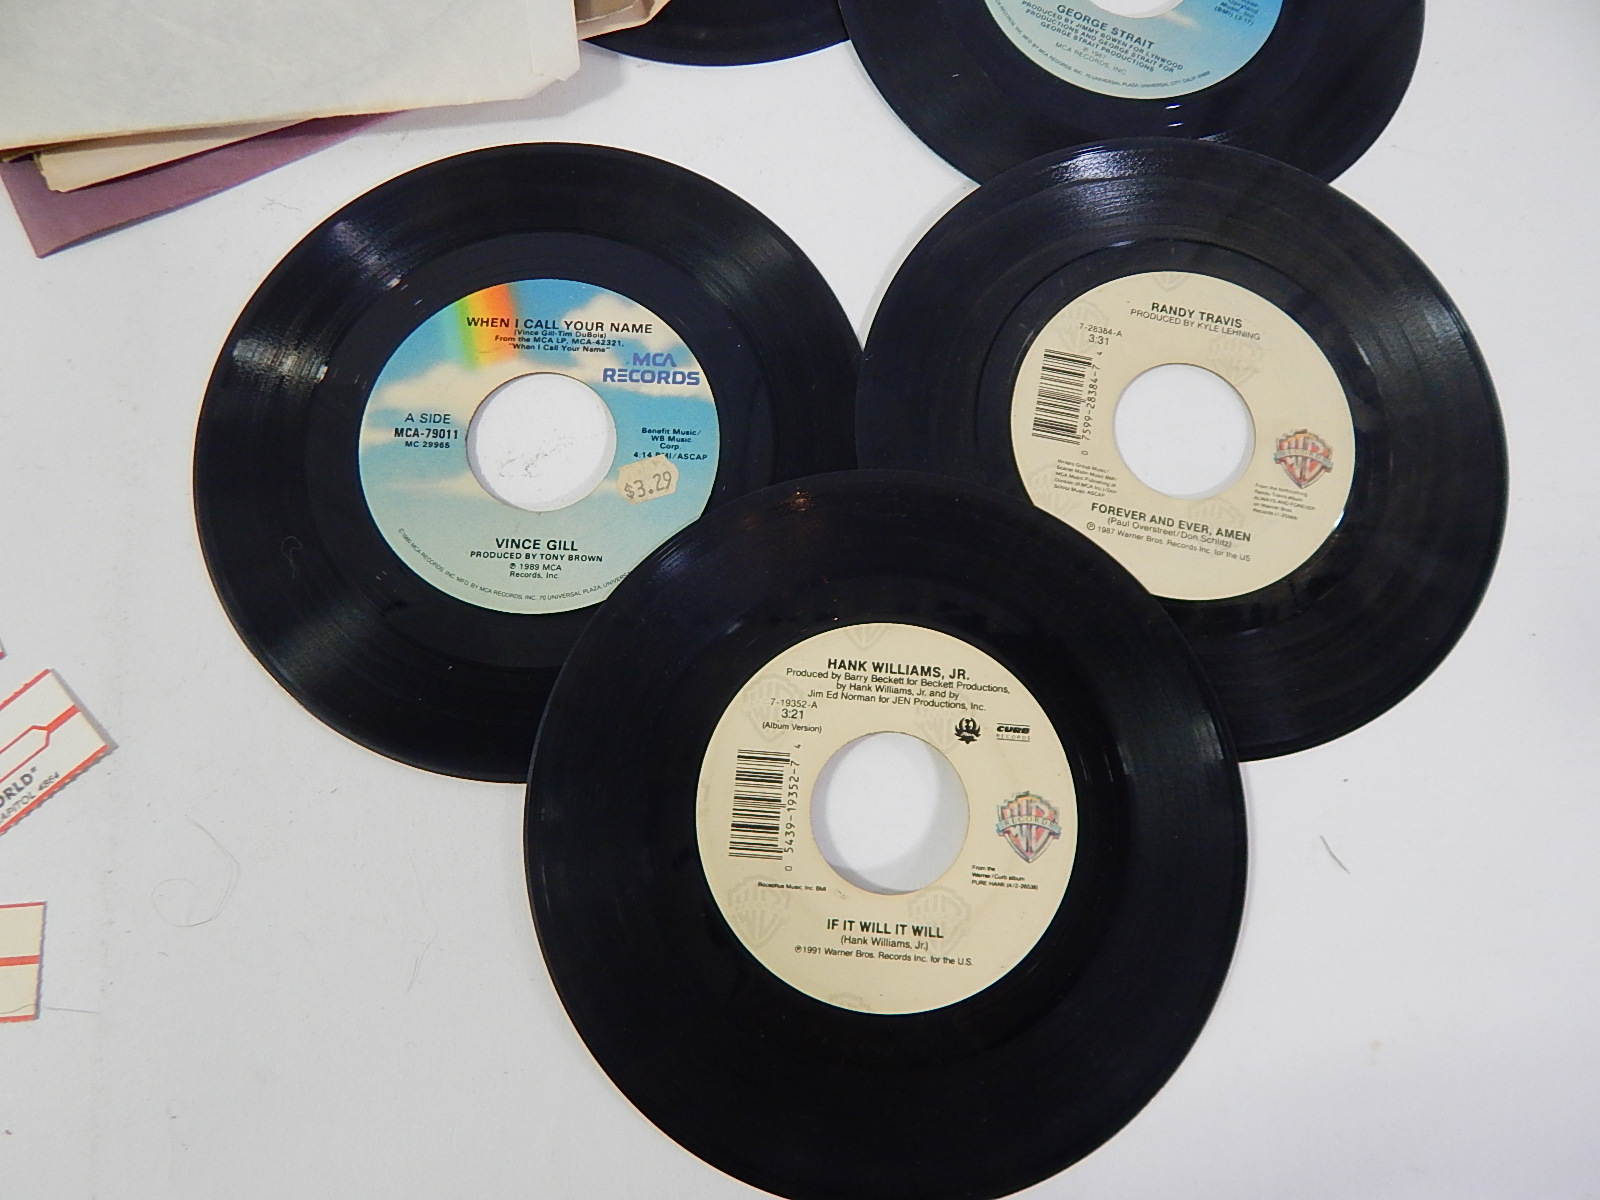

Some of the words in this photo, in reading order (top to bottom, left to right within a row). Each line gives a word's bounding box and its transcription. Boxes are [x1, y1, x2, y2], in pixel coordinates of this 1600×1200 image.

[1057, 4, 1108, 31] GEORGE
[1111, 27, 1155, 49] STRAIT
[1021, 0, 1062, 20] PRODUCED
[1064, 17, 1074, 25] BY
[1075, 22, 1099, 35] JIMMY
[1100, 32, 1128, 48] BOWEN
[1128, 44, 1145, 54] FOR
[1146, 51, 1184, 70] LYNWOOD
[1025, 8, 1079, 34] PRODUCTIONS
[1080, 31, 1097, 41] AND
[1098, 38, 1129, 55] GEORGE
[1130, 51, 1157, 66] STRAIT
[1158, 63, 1175, 73] FOR
[1040, 21, 1071, 38] GEORGE
[1072, 35, 1099, 50] STRAIT
[1100, 46, 1155, 73] PRODUCTIONS
[1055, 41, 1072, 53] MCA
[1151, 302, 1195, 319] RANDY
[1198, 311, 1243, 328] TRAVIS
[466, 316, 510, 329] WHEN
[514, 318, 519, 328] I
[523, 318, 559, 330] CALL
[564, 320, 605, 332] YOUR
[609, 322, 653, 334] NAME
[1079, 322, 1123, 338] 7-28384-A
[1130, 308, 1181, 325] PRODUCED
[1183, 318, 1195, 327] BY
[1197, 322, 1219, 333] KYLE
[1221, 326, 1261, 341] LEHNING
[495, 334, 516, 342] From
[518, 335, 532, 343] the
[533, 336, 553, 344] MCA
[541, 329, 572, 338] Gill-Tim
[575, 331, 607, 339] DuBois)
[1088, 334, 1110, 345] 3:31
[561, 344, 580, 352] Your
[632, 352, 677, 367] MCA
[602, 368, 700, 386] RECORDS
[404, 412, 415, 423] A
[419, 412, 451, 424] SIDE
[394, 427, 459, 439] MCA-79011
[641, 427, 670, 435] Benefit
[672, 428, 702, 436] Music/
[667, 435, 692, 443] Music
[659, 442, 682, 451] Corp.
[624, 471, 672, 499] $3.29
[1091, 502, 1147, 522] FOREVER
[1150, 514, 1175, 528] AND
[1178, 519, 1212, 536] EVER,
[1215, 527, 1252, 542] AMEN
[1107, 516, 1130, 528] (Paul
[1200, 534, 1232, 548] Schlitz)
[495, 538, 541, 550] VINCE
[546, 539, 578, 551] GILL
[1097, 525, 1115, 535] 1987
[1117, 529, 1144, 541] Warner
[1166, 538, 1197, 552] Records
[1214, 548, 1224, 556] for
[1226, 550, 1238, 560] the
[470, 550, 522, 560] PRODUCED
[525, 552, 537, 560] BY
[540, 553, 565, 561] TONY
[568, 554, 603, 562] BROWN
[509, 571, 543, 579] Records,
[519, 563, 540, 571] 1989
[542, 563, 562, 571] MCA
[479, 586, 492, 594] MCA
[547, 590, 582, 600] UNIVERSAL
[827, 658, 868, 672] HANK
[872, 661, 945, 680] WILLIAMS,
[949, 668, 970, 680] JR.
[786, 667, 829, 679] Produced
[831, 671, 842, 682] by
[844, 672, 869, 683] Barry
[871, 674, 904, 685] Beckett
[906, 677, 918, 686] for
[920, 678, 954, 689] Beckett
[956, 680, 1011, 694] Productions,
[836, 681, 847, 691] by
[849, 682, 873, 692] Hank
[875, 684, 914, 697] Williams,
[916, 688, 927, 697] Jr.
[929, 690, 947, 698] and
[949, 691, 960, 700] by
[770, 698, 818, 709] 7-19352-A
[807, 690, 823, 698] Jim
[826, 690, 839, 699] Ed
[841, 691, 876, 703] Norman
[878, 695, 890, 704] for
[892, 696, 911, 705] JEN
[913, 697, 968, 711] Productions,
[970, 702, 987, 711] Inc.
[781, 708, 804, 720] 3:21
[762, 721, 790, 731] (Album
[791, 723, 823, 734] Version)
[996, 725, 1031, 734] CURB
[783, 760, 801, 854] 5439-19352-7
[827, 918, 839, 930] IF
[843, 920, 855, 931] IT
[859, 921, 891, 934] WILL
[895, 923, 908, 935] IT
[911, 924, 944, 938] WILL
[840, 934, 868, 945] (Hank
[871, 936, 912, 950] Williams,
[915, 940, 929, 951] Jr.)
[824, 947, 853, 957] Warner
[856, 949, 876, 959] Bros.
[878, 951, 911, 962] Records
[913, 954, 928, 963] Inc.
[930, 955, 940, 963] for
[943, 956, 955, 965] the
[957, 957, 973, 966] U.S.
